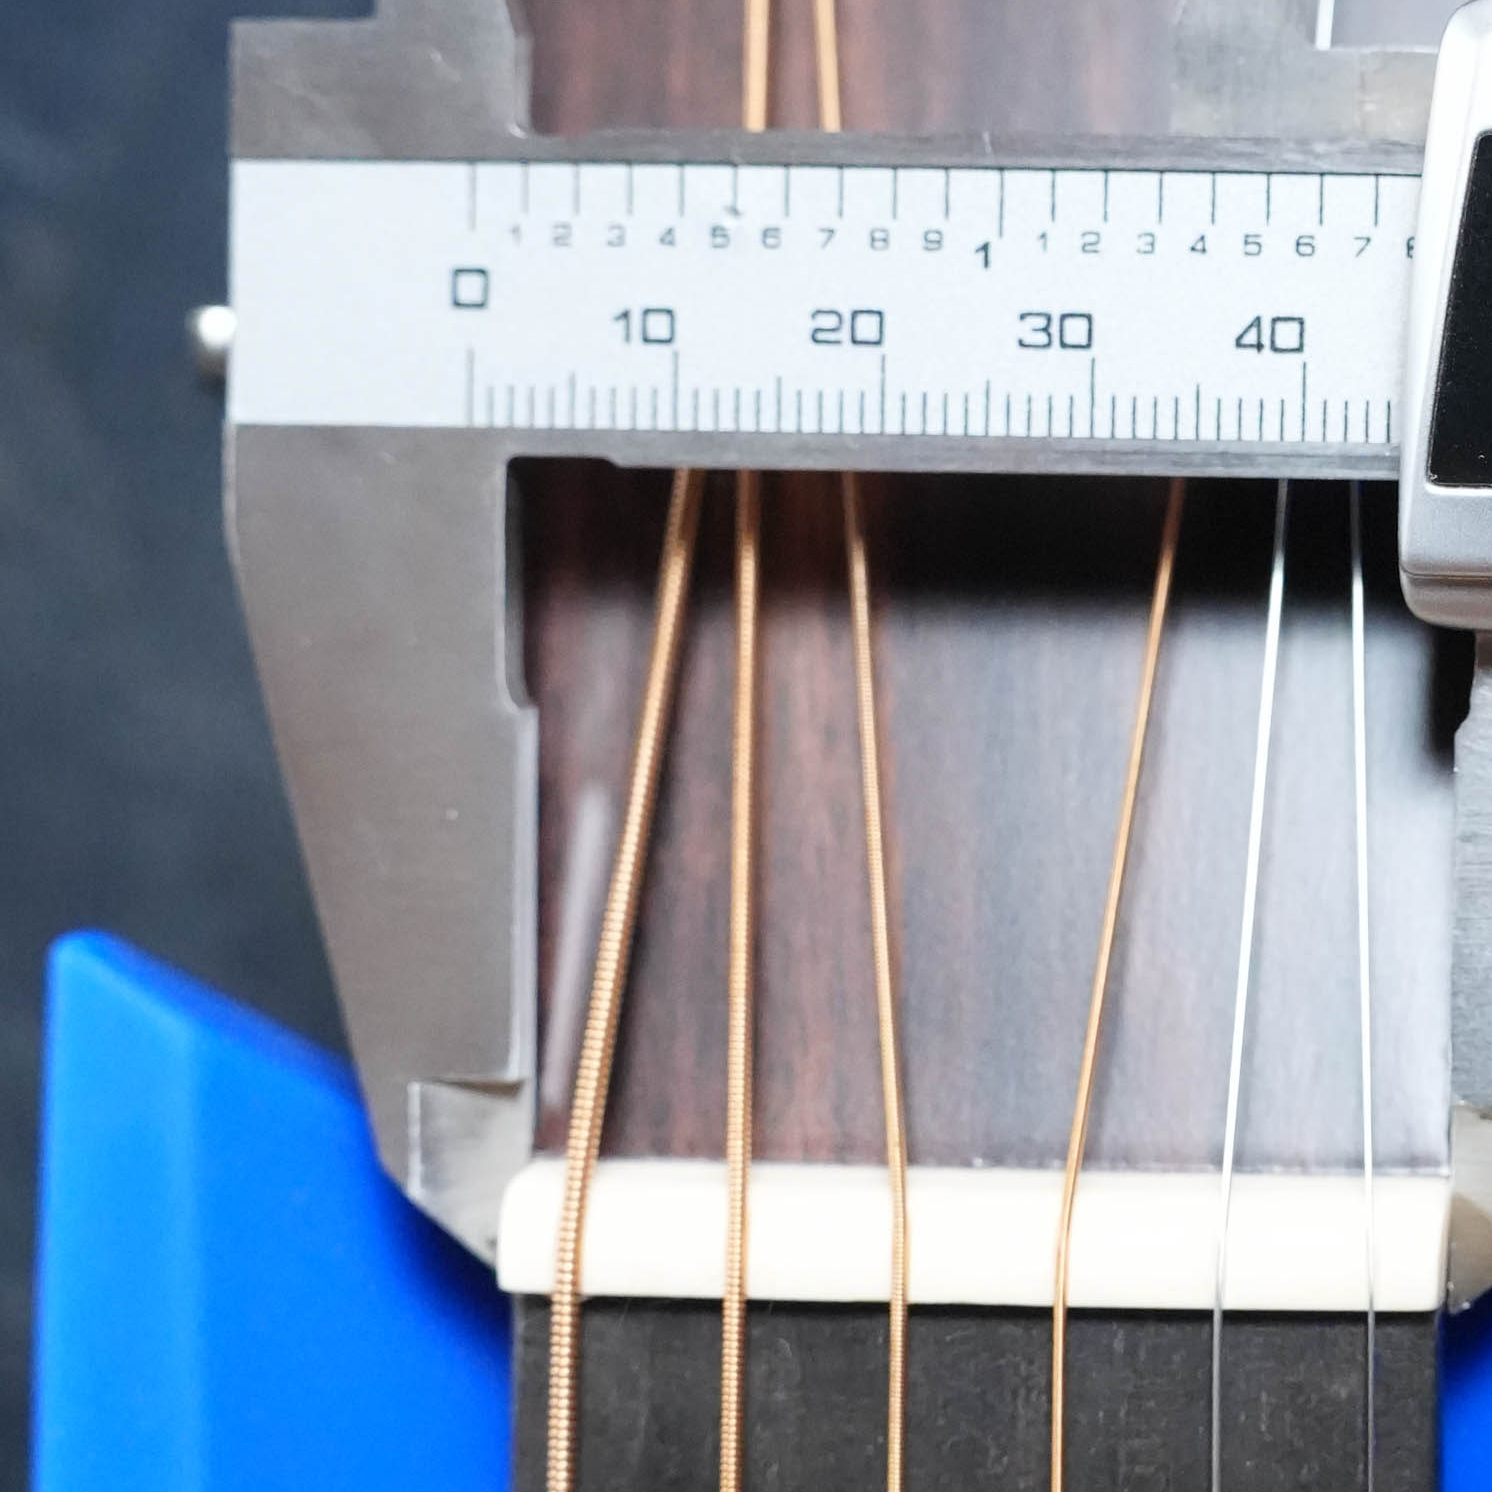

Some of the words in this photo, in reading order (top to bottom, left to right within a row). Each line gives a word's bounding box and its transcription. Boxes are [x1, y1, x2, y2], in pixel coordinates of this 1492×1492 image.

[552, 223, 572, 247] 2
[606, 224, 626, 248] 3
[659, 226, 677, 248] 4
[710, 225, 730, 249] 5
[761, 227, 781, 249] 6
[818, 227, 836, 249] 7
[869, 228, 890, 251] 8
[923, 229, 944, 251] 9
[974, 241, 992, 271] 1
[1036, 231, 1049, 252] 1
[1080, 231, 1101, 254] 2
[1135, 232, 1156, 255] 3
[1189, 234, 1208, 256] 4
[1242, 233, 1263, 257] 5
[1295, 234, 1316, 258] 6
[1353, 235, 1373, 259] 7
[451, 267, 490, 310] 0
[613, 307, 676, 346] 10
[810, 309, 885, 347] 20
[1017, 311, 1094, 351] 30
[1234, 314, 1306, 355] 40
